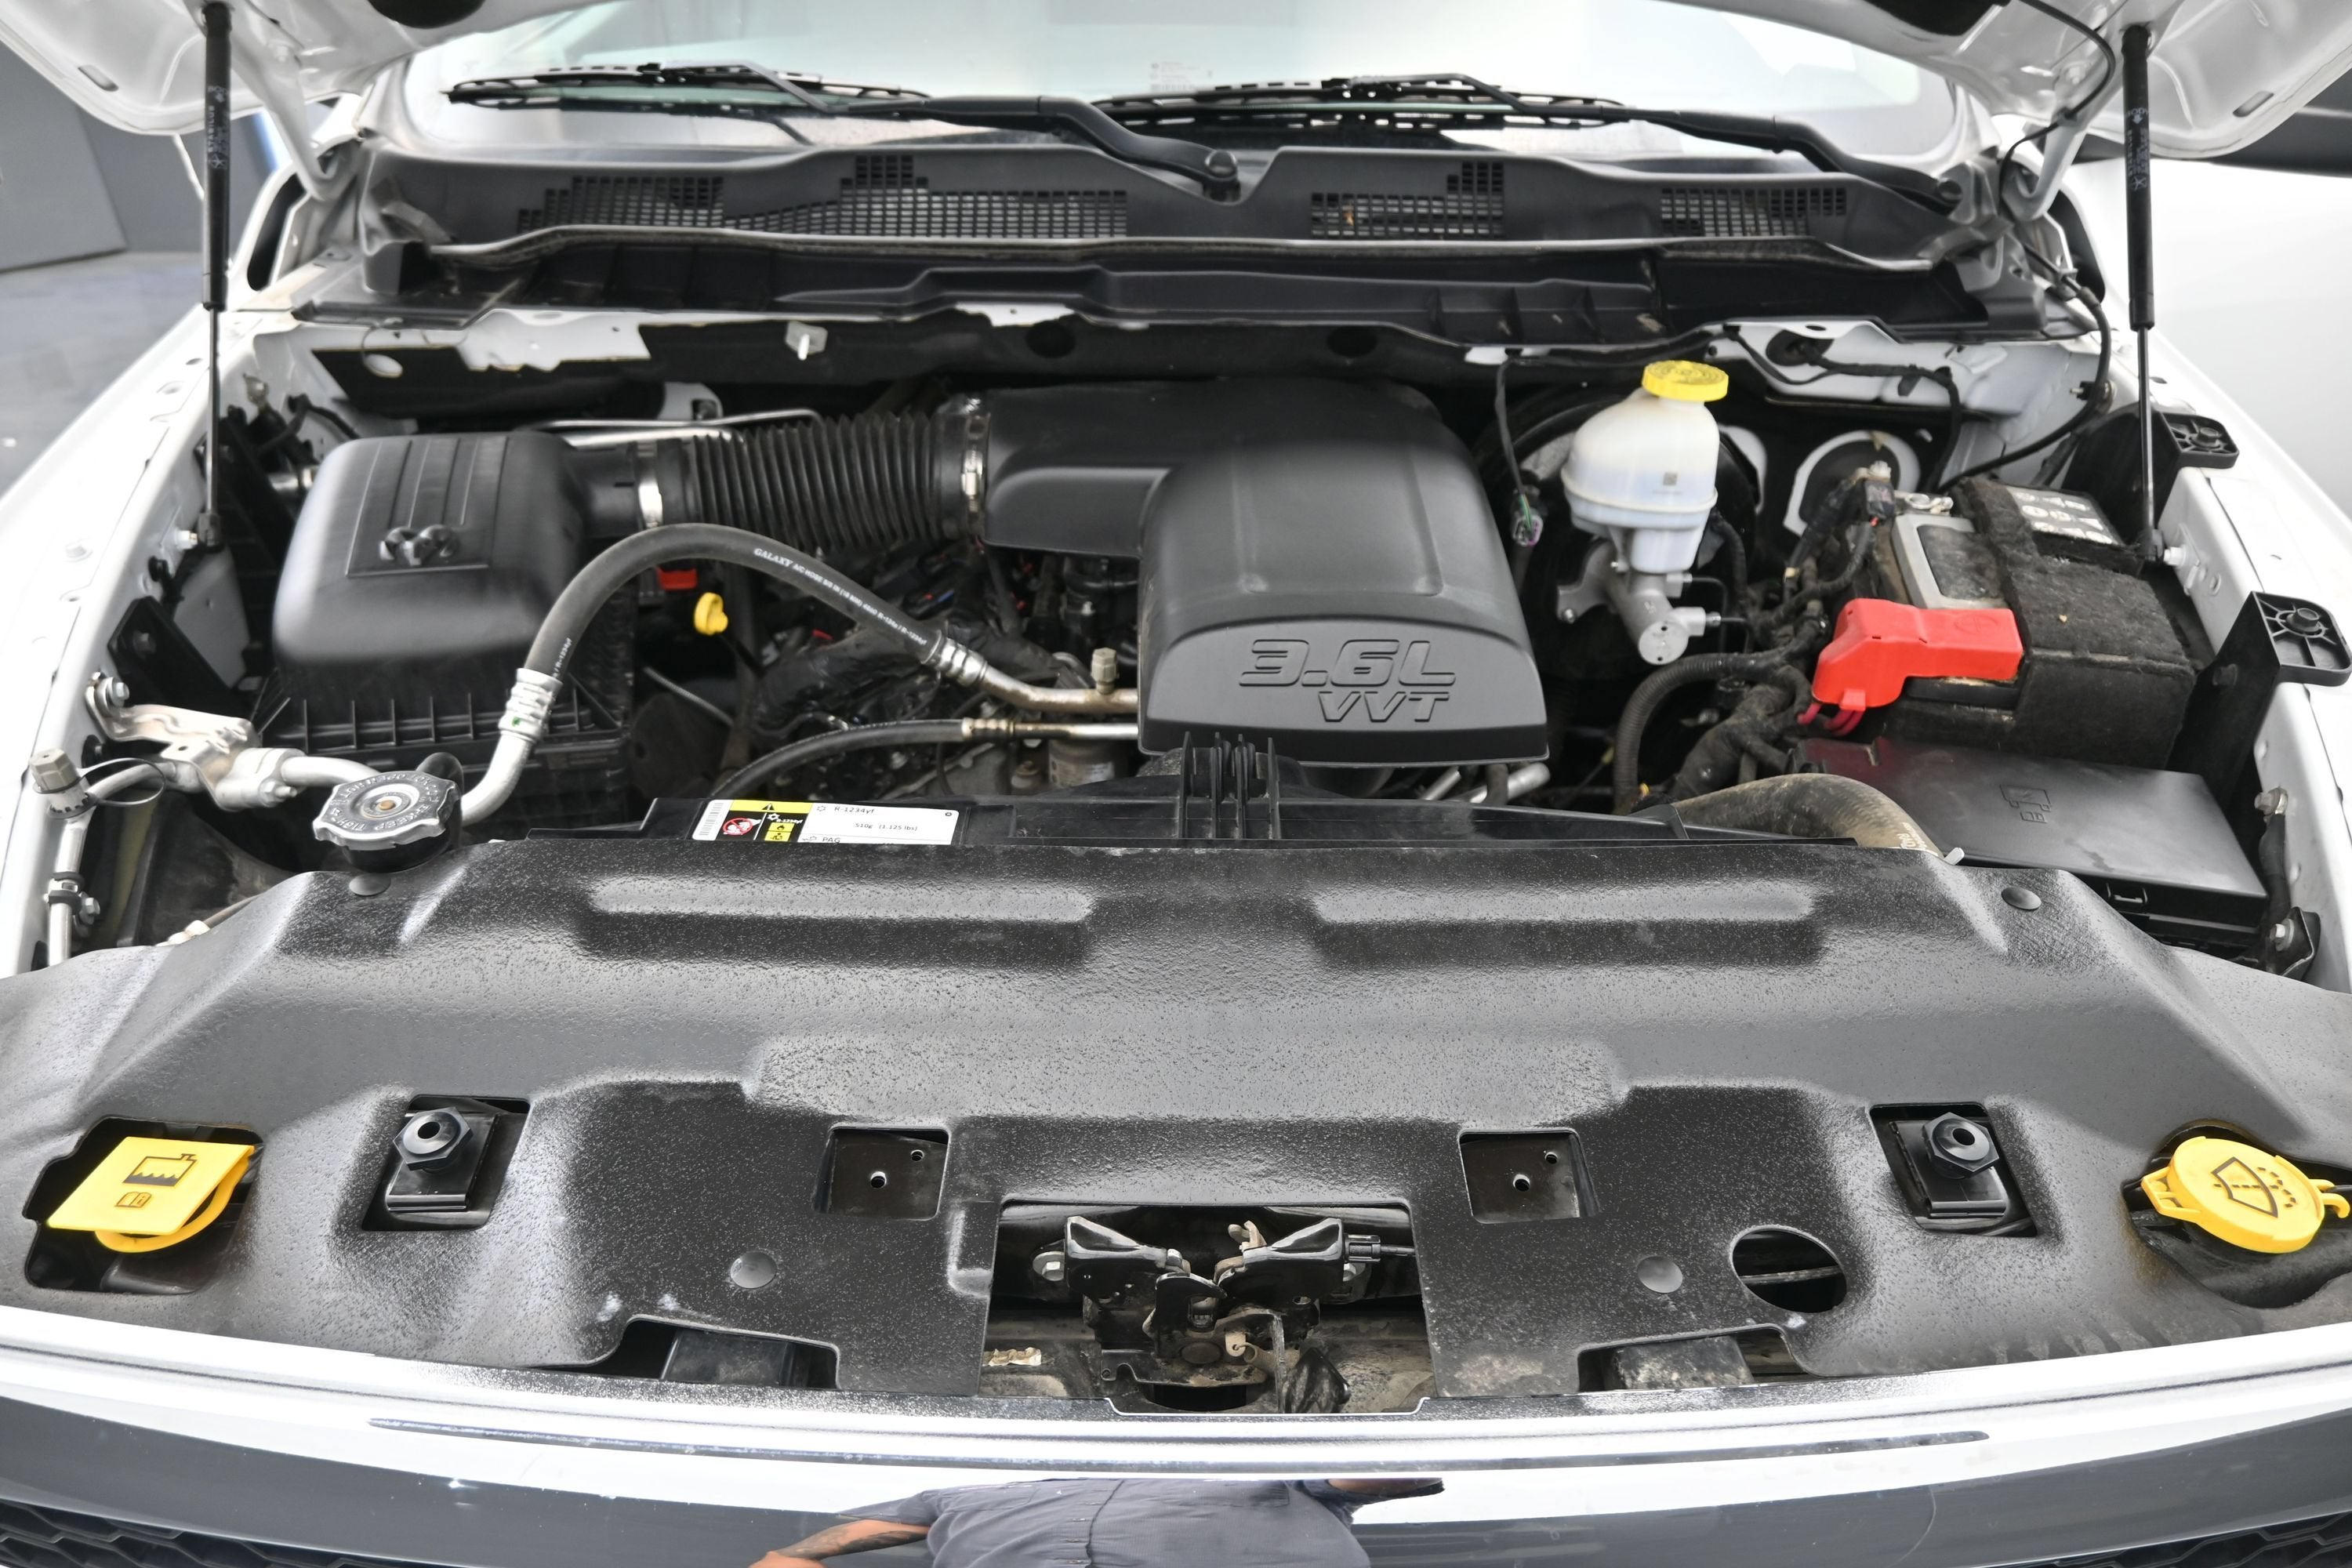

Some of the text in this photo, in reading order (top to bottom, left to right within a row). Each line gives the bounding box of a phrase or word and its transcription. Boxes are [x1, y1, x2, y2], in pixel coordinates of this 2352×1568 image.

[753, 548, 793, 568] GALAXY
[804, 569, 823, 583] HOSE
[1238, 639, 1457, 687] 3.6L
[1318, 691, 1450, 723] VVT
[834, 806, 876, 815] R-1234yf
